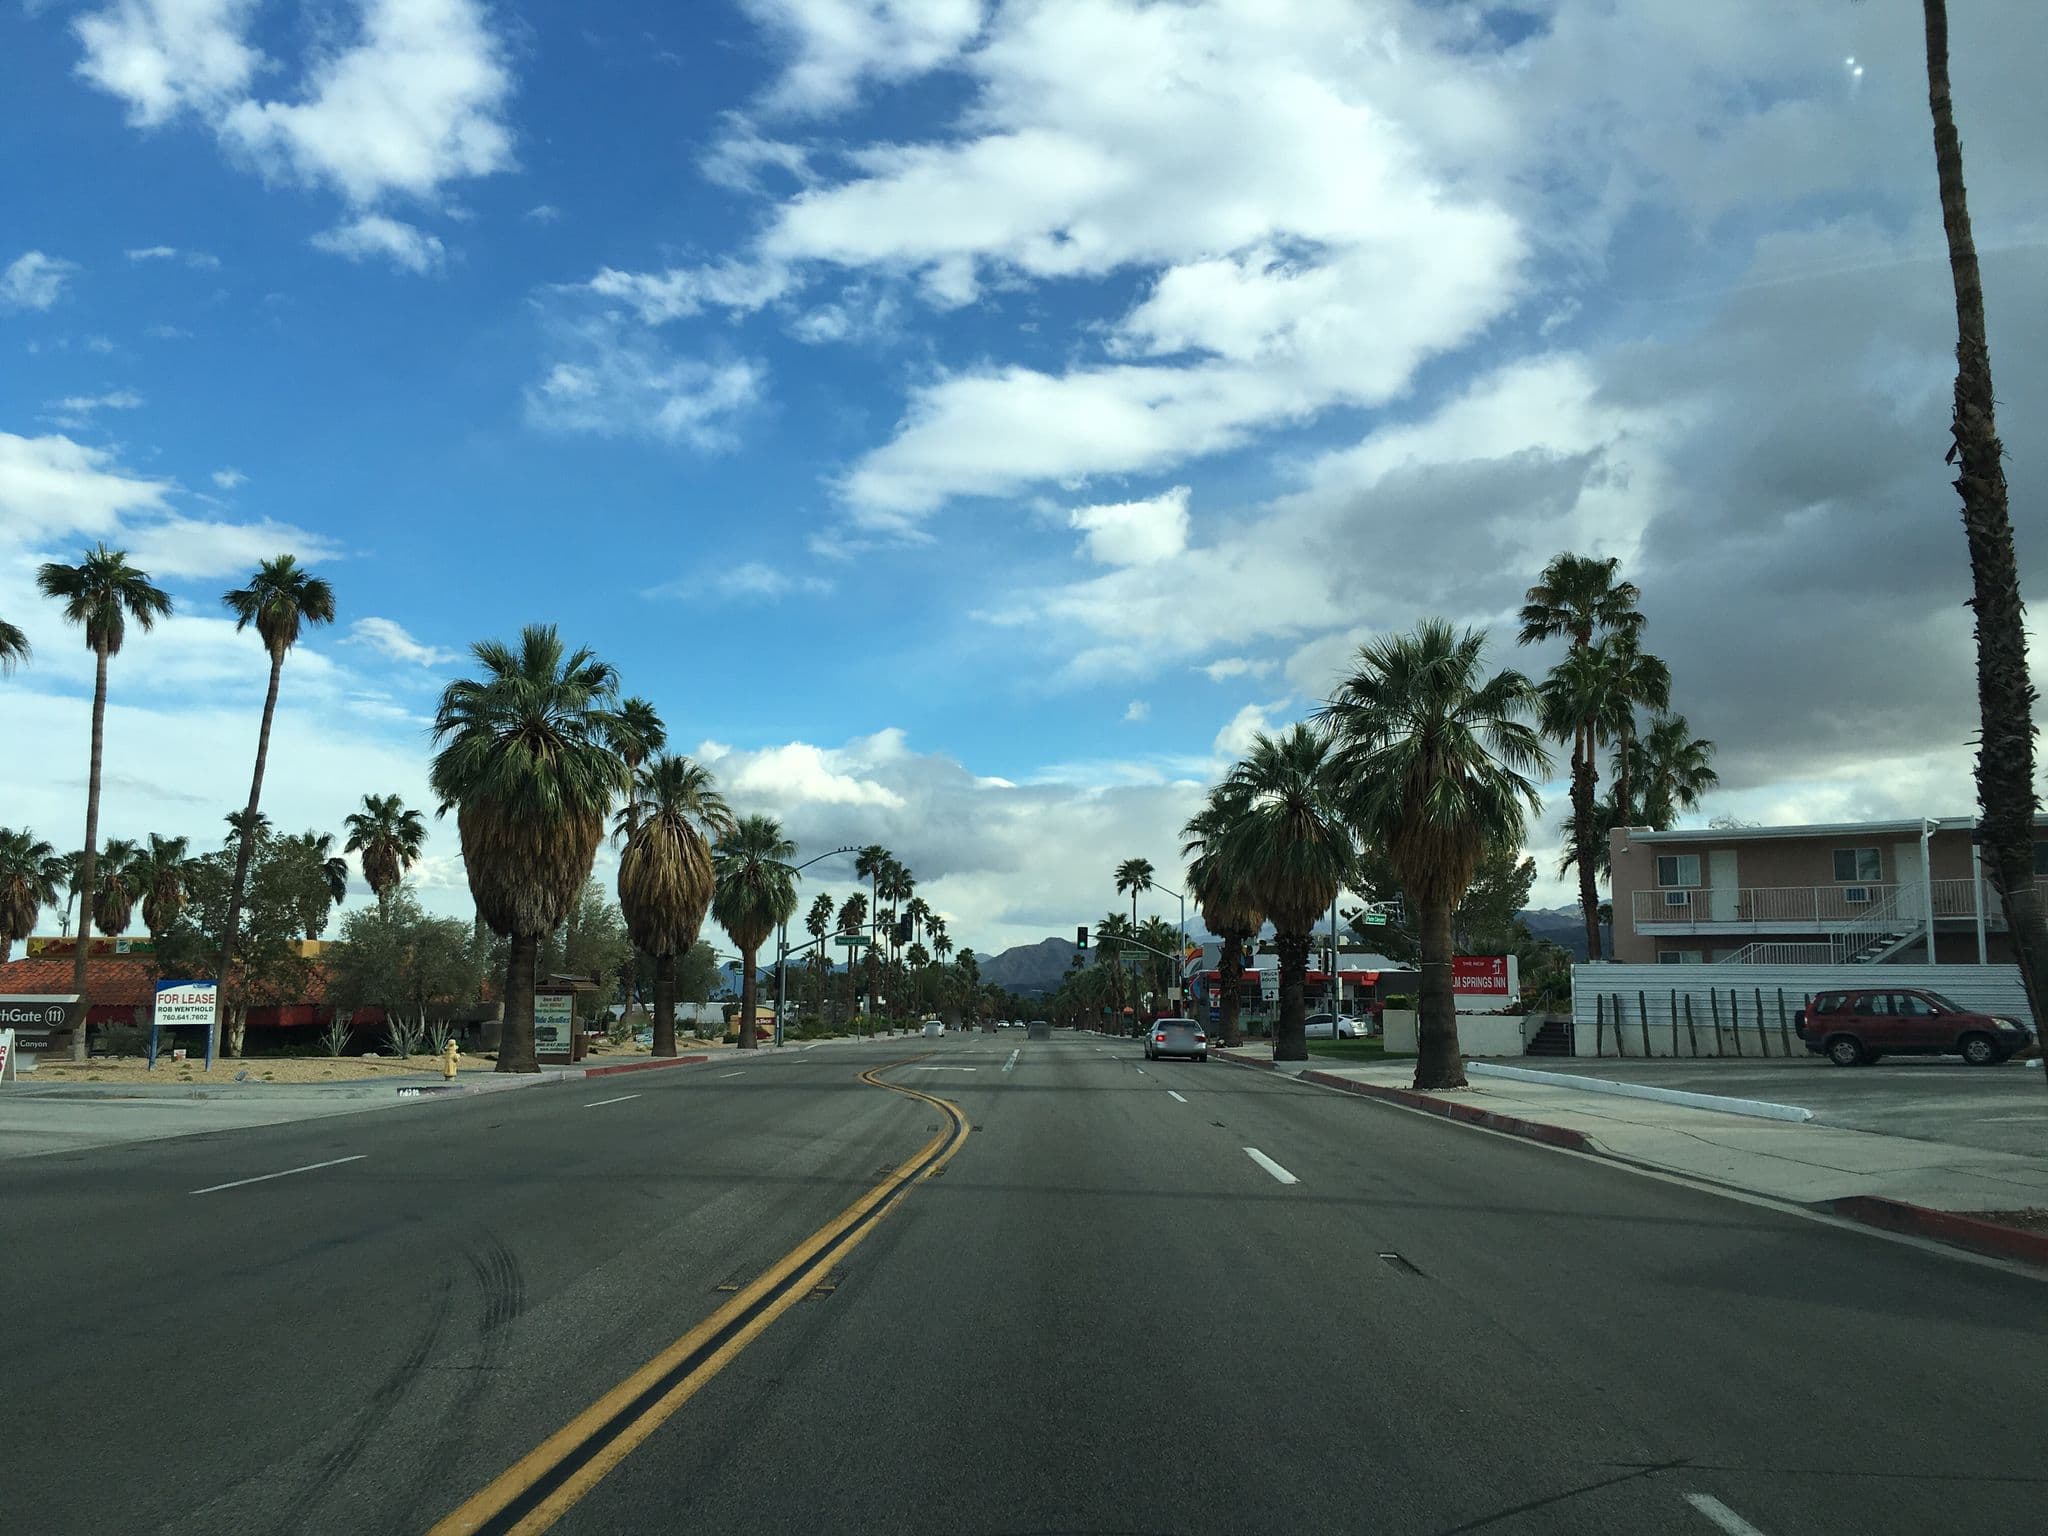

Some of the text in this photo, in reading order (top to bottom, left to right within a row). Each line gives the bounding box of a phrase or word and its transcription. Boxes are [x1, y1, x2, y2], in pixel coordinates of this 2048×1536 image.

[1462, 976, 1492, 988] SPRINGS
[1493, 976, 1506, 988] INN
[157, 993, 215, 1004] FOR LEASE
[0, 1008, 42, 1022] hGate
[20, 1039, 48, 1048] Canyon
